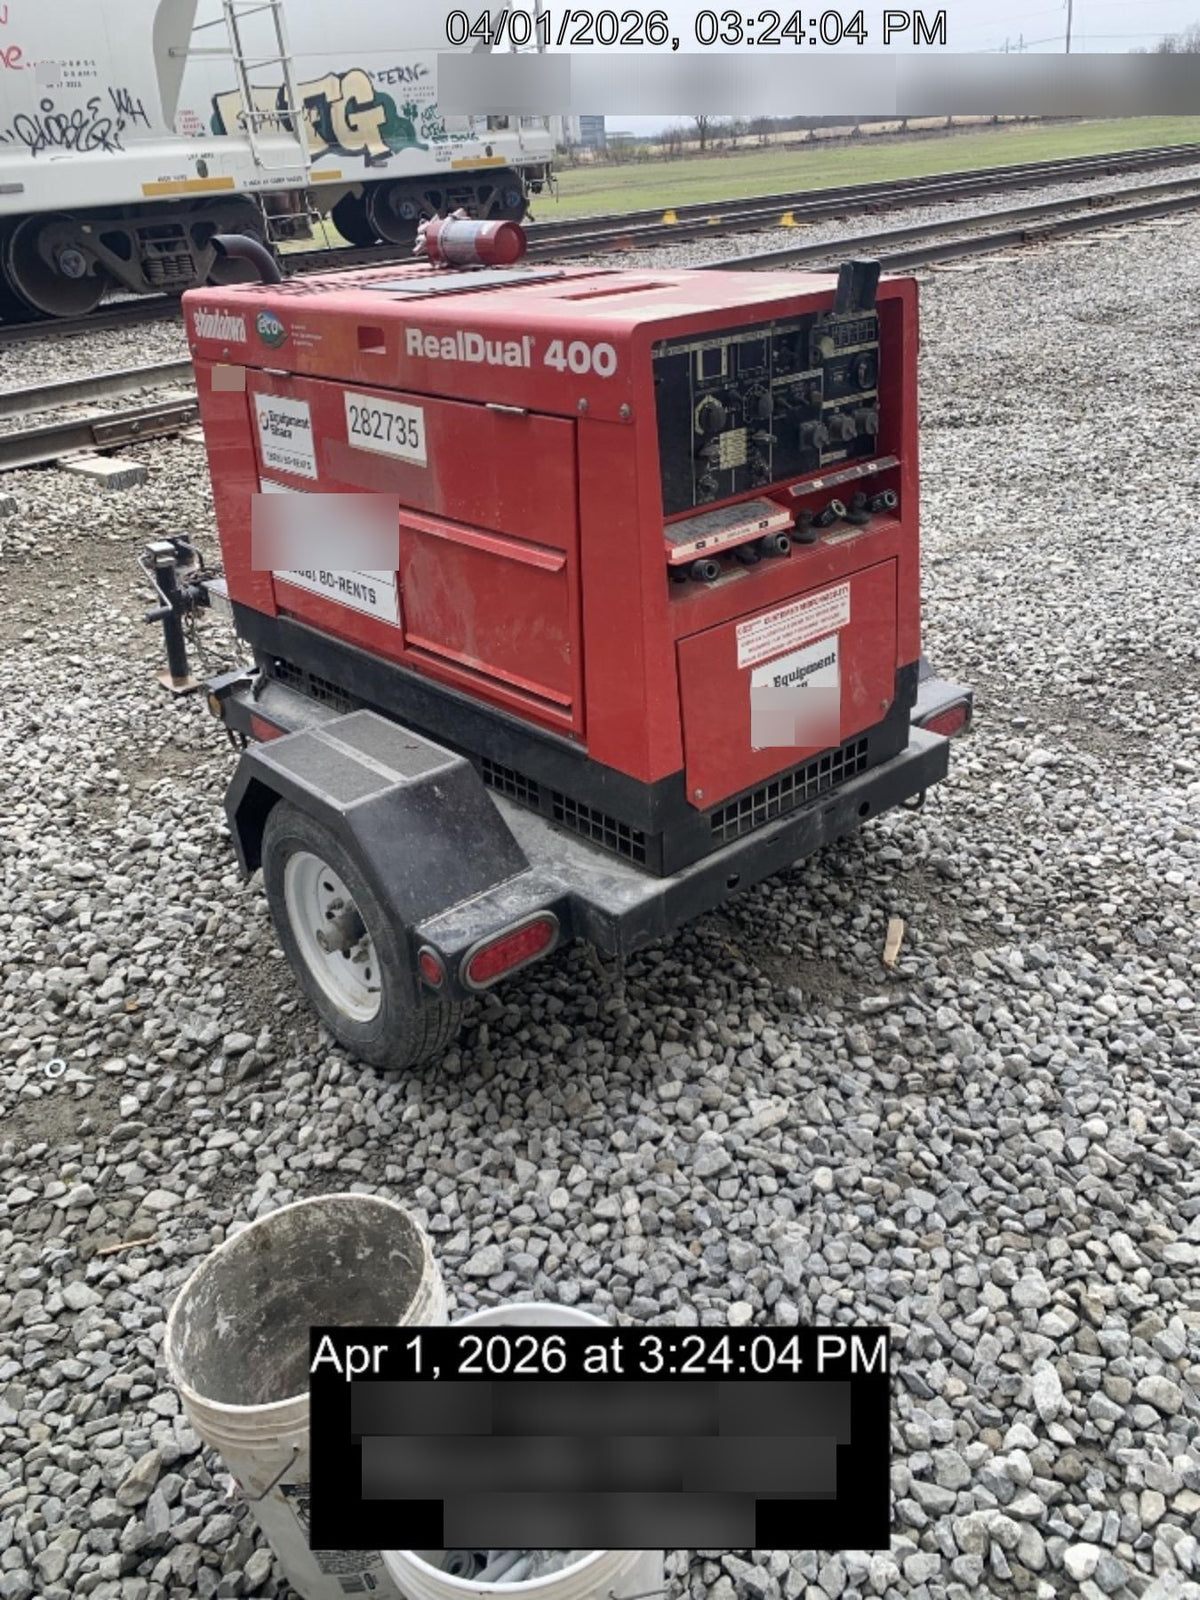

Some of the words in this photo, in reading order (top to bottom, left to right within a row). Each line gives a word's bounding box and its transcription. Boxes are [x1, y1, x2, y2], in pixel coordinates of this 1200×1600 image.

[543, 339, 618, 378] 400
[349, 405, 420, 449] 282735
[773, 652, 836, 688] Equipment
